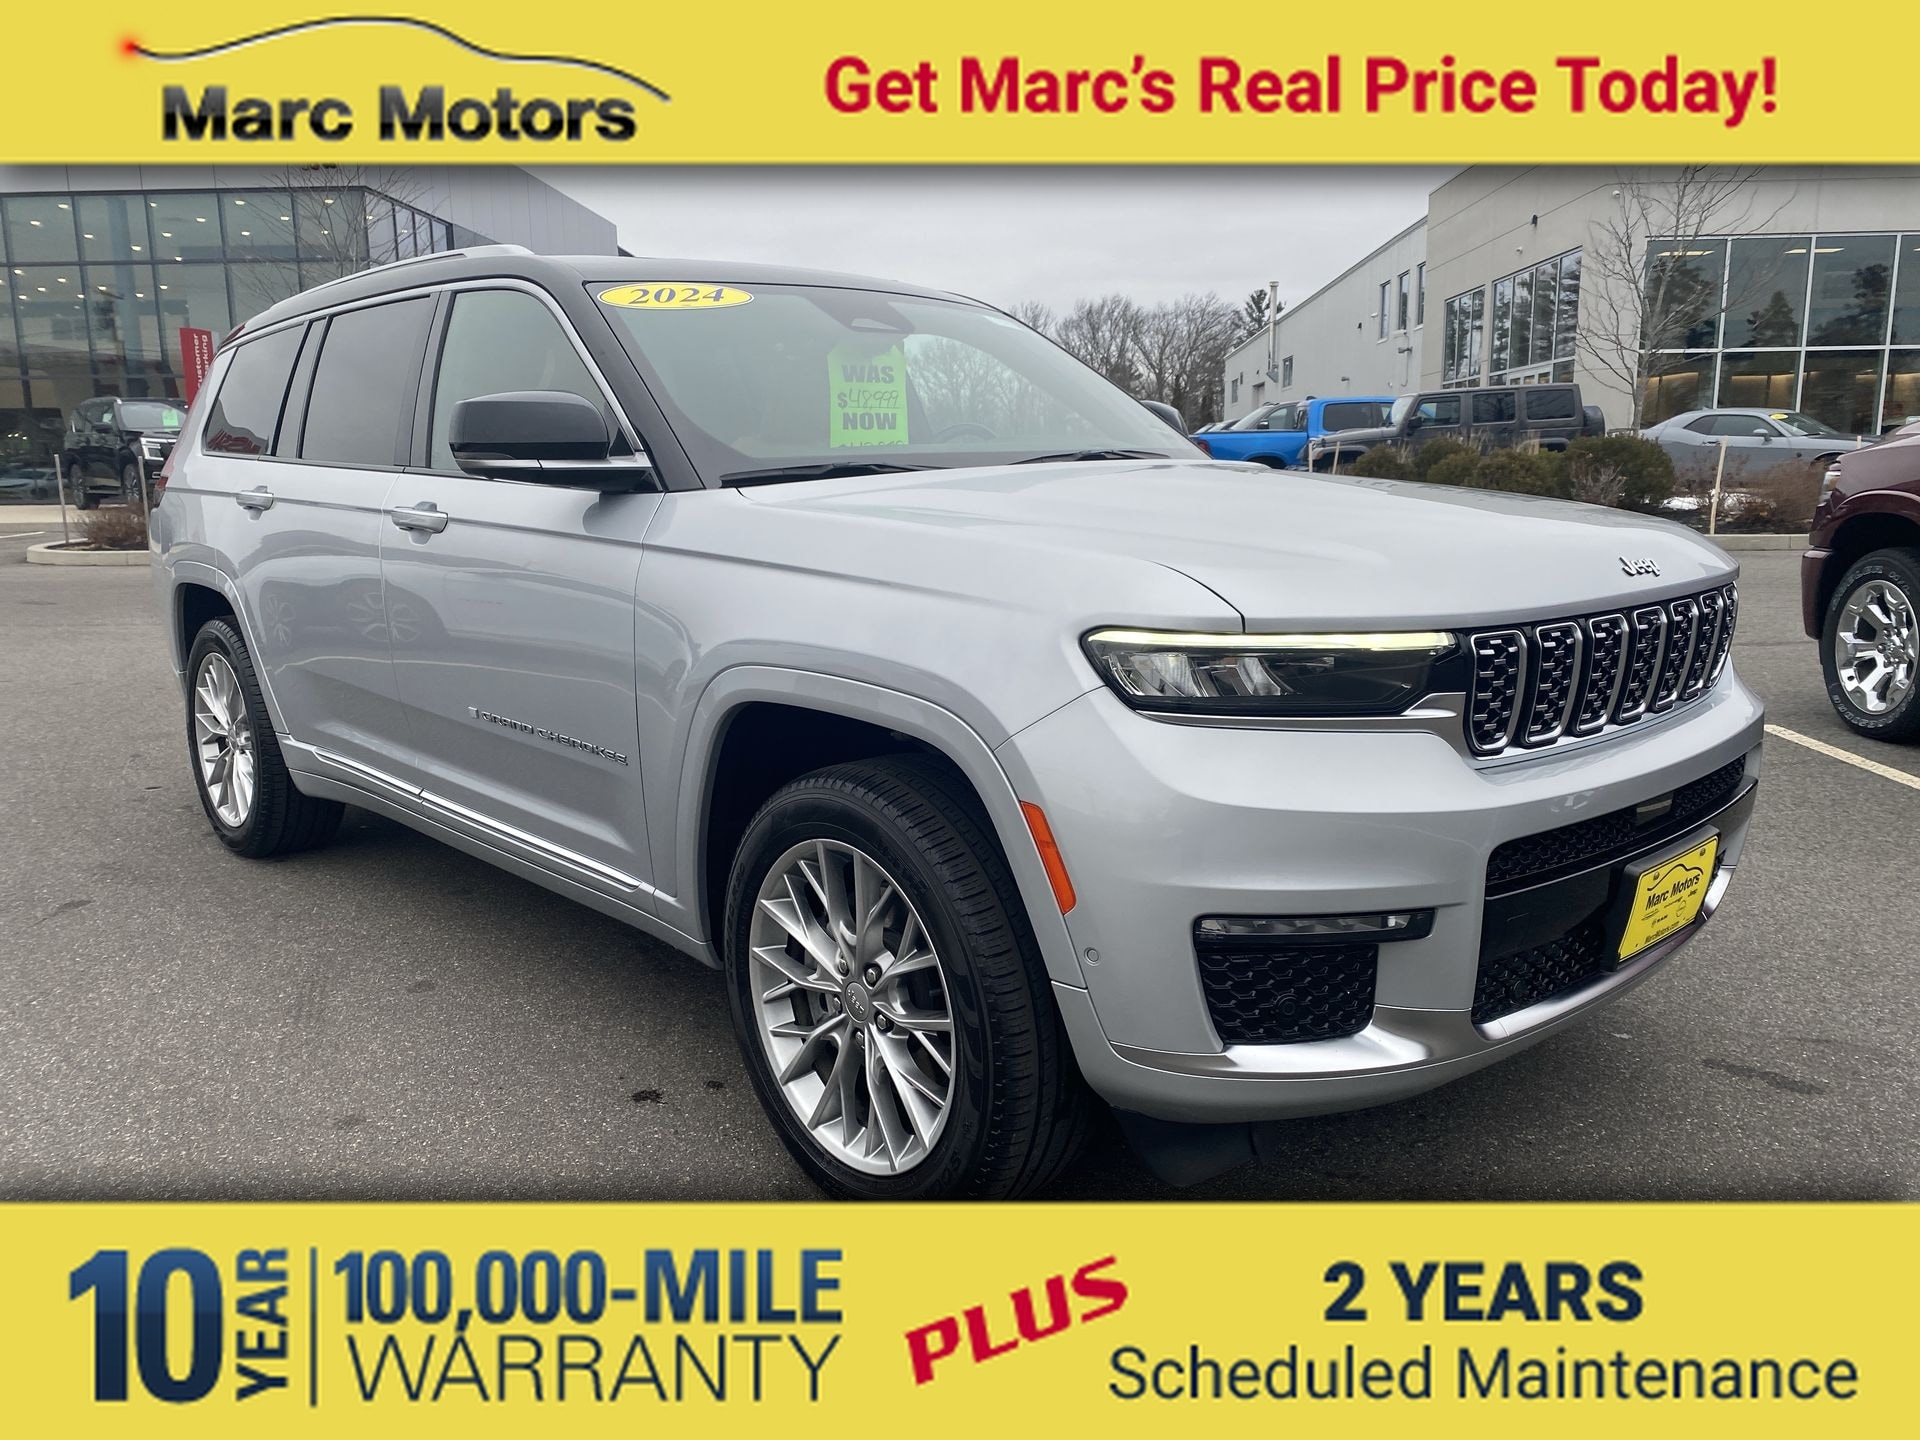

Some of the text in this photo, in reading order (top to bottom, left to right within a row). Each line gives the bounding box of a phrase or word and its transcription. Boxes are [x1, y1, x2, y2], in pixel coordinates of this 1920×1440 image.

[628, 287, 724, 305] 2024
[841, 363, 895, 384] WAS
[842, 412, 897, 431] NOW
[1618, 555, 1661, 578] Jeep
[481, 711, 629, 766] GRAND CHEROKEE
[1645, 890, 1669, 911] Marc
[1670, 874, 1701, 898] Motors
